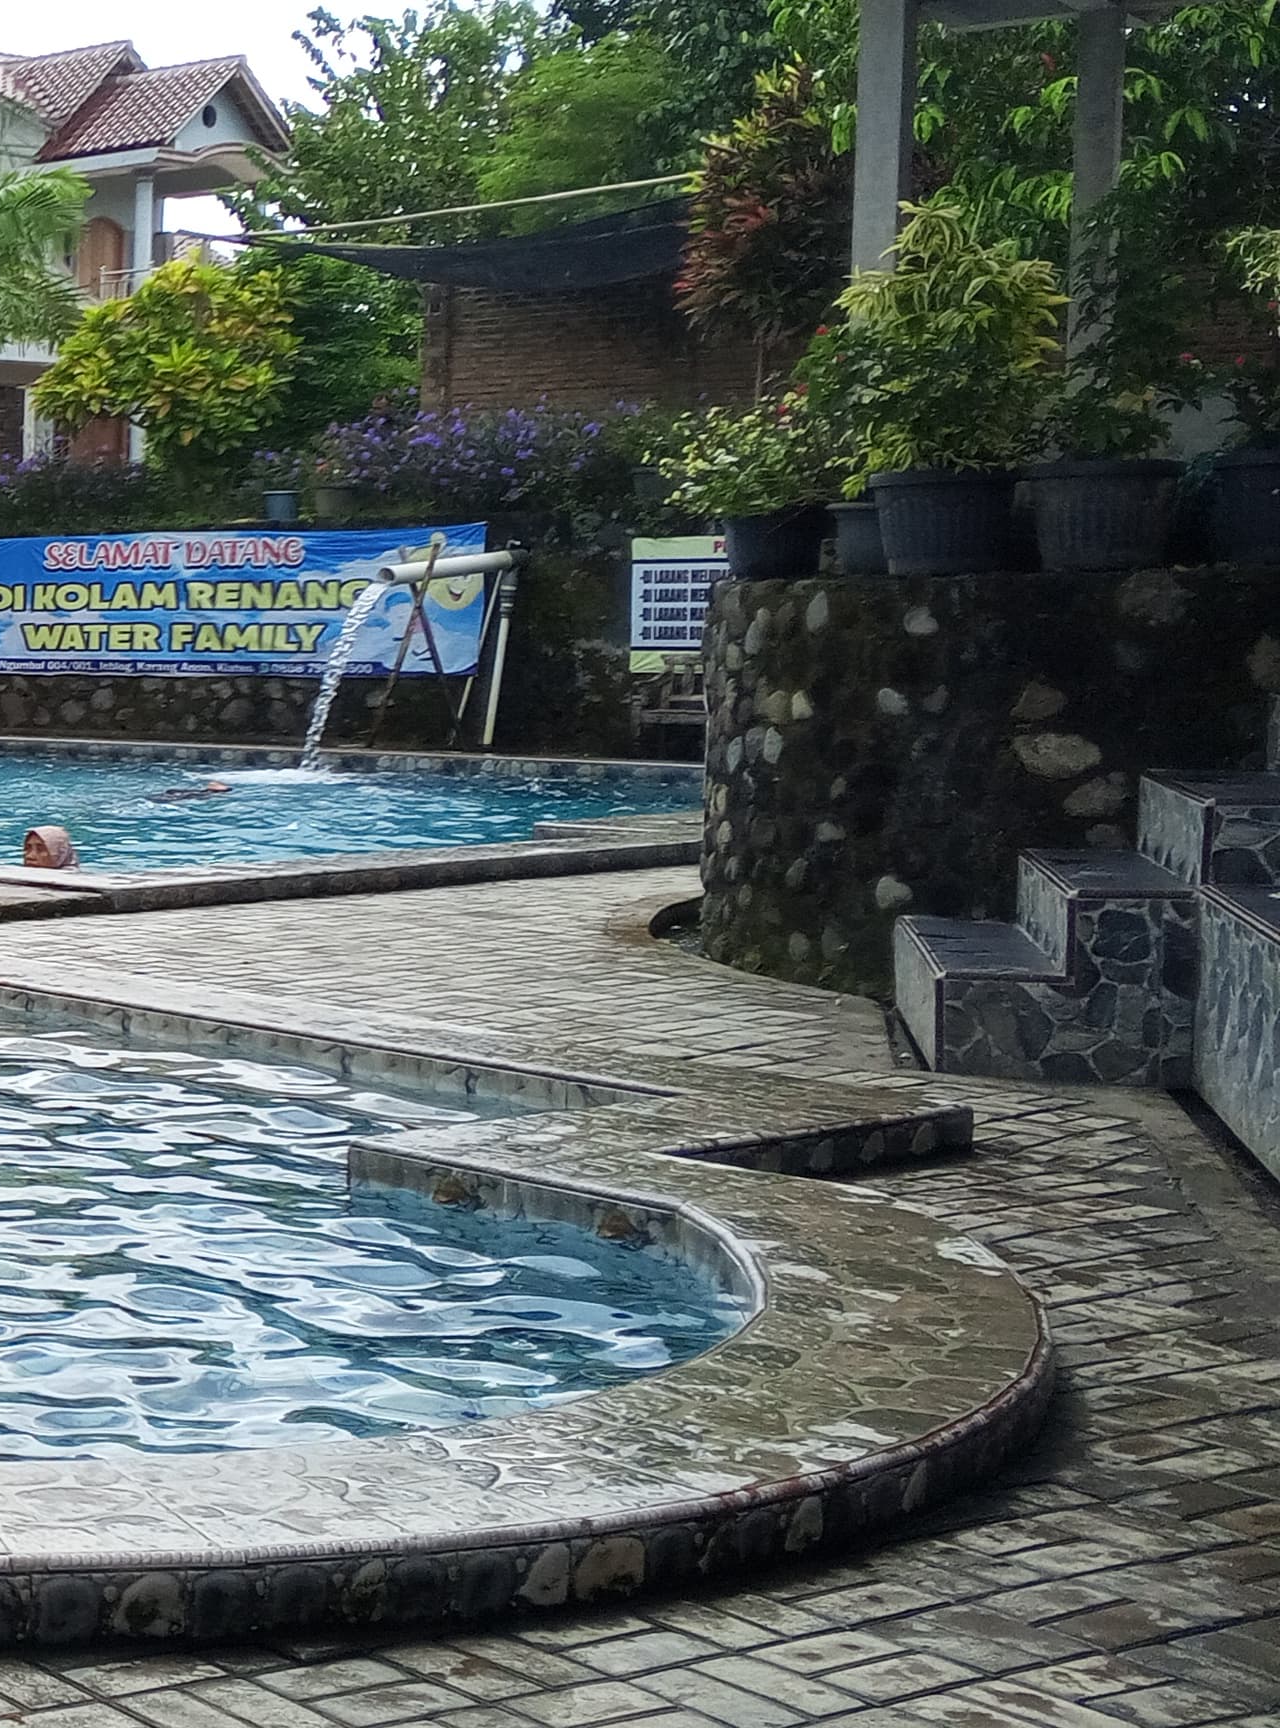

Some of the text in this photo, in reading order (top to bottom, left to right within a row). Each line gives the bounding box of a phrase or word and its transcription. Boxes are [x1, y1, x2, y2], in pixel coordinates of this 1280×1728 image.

[45, 536, 304, 571] SELAMAT DATANG
[32, 581, 179, 612] KOLAM
[21, 621, 327, 652] WATER FAMILY
